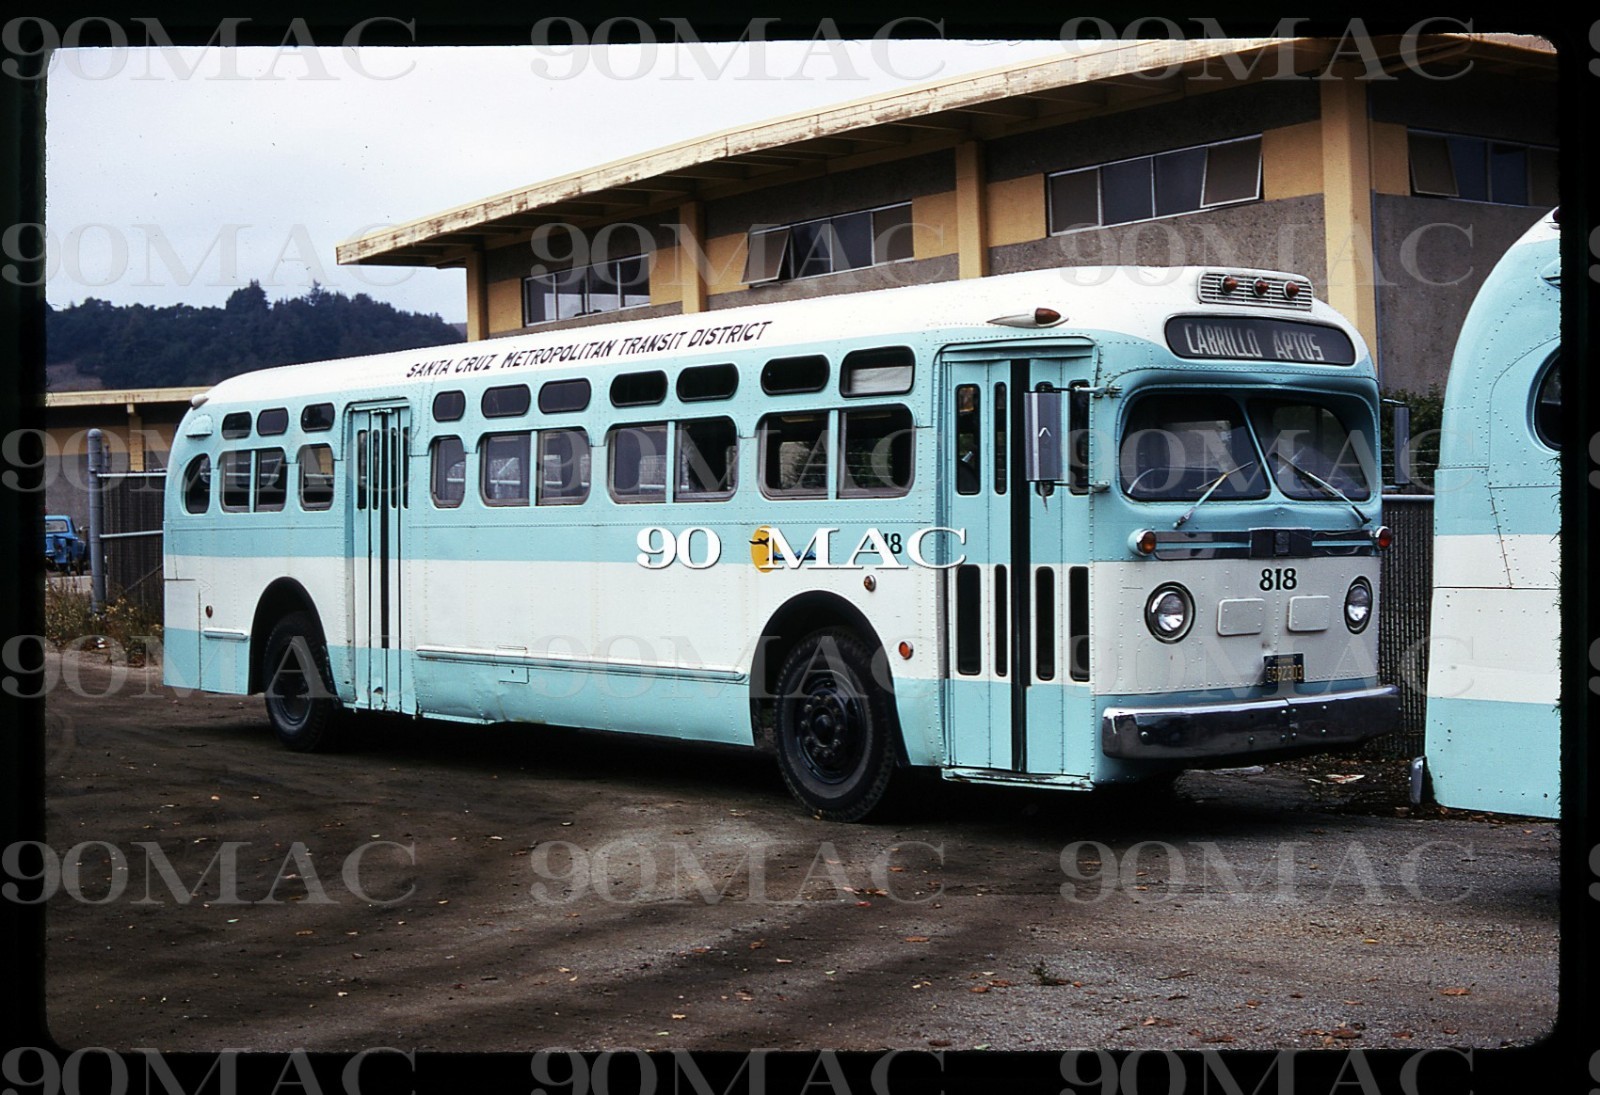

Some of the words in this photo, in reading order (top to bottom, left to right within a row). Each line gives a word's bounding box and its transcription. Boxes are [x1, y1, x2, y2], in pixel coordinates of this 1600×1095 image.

[406, 359, 454, 378] SANTA
[455, 353, 499, 373] CRUZ
[500, 339, 619, 369] METROPOLITAN
[618, 331, 688, 356] TRANSIT
[687, 321, 773, 348] DISTRICT
[1273, 330, 1325, 361] APTOS
[1259, 568, 1297, 591] 818
